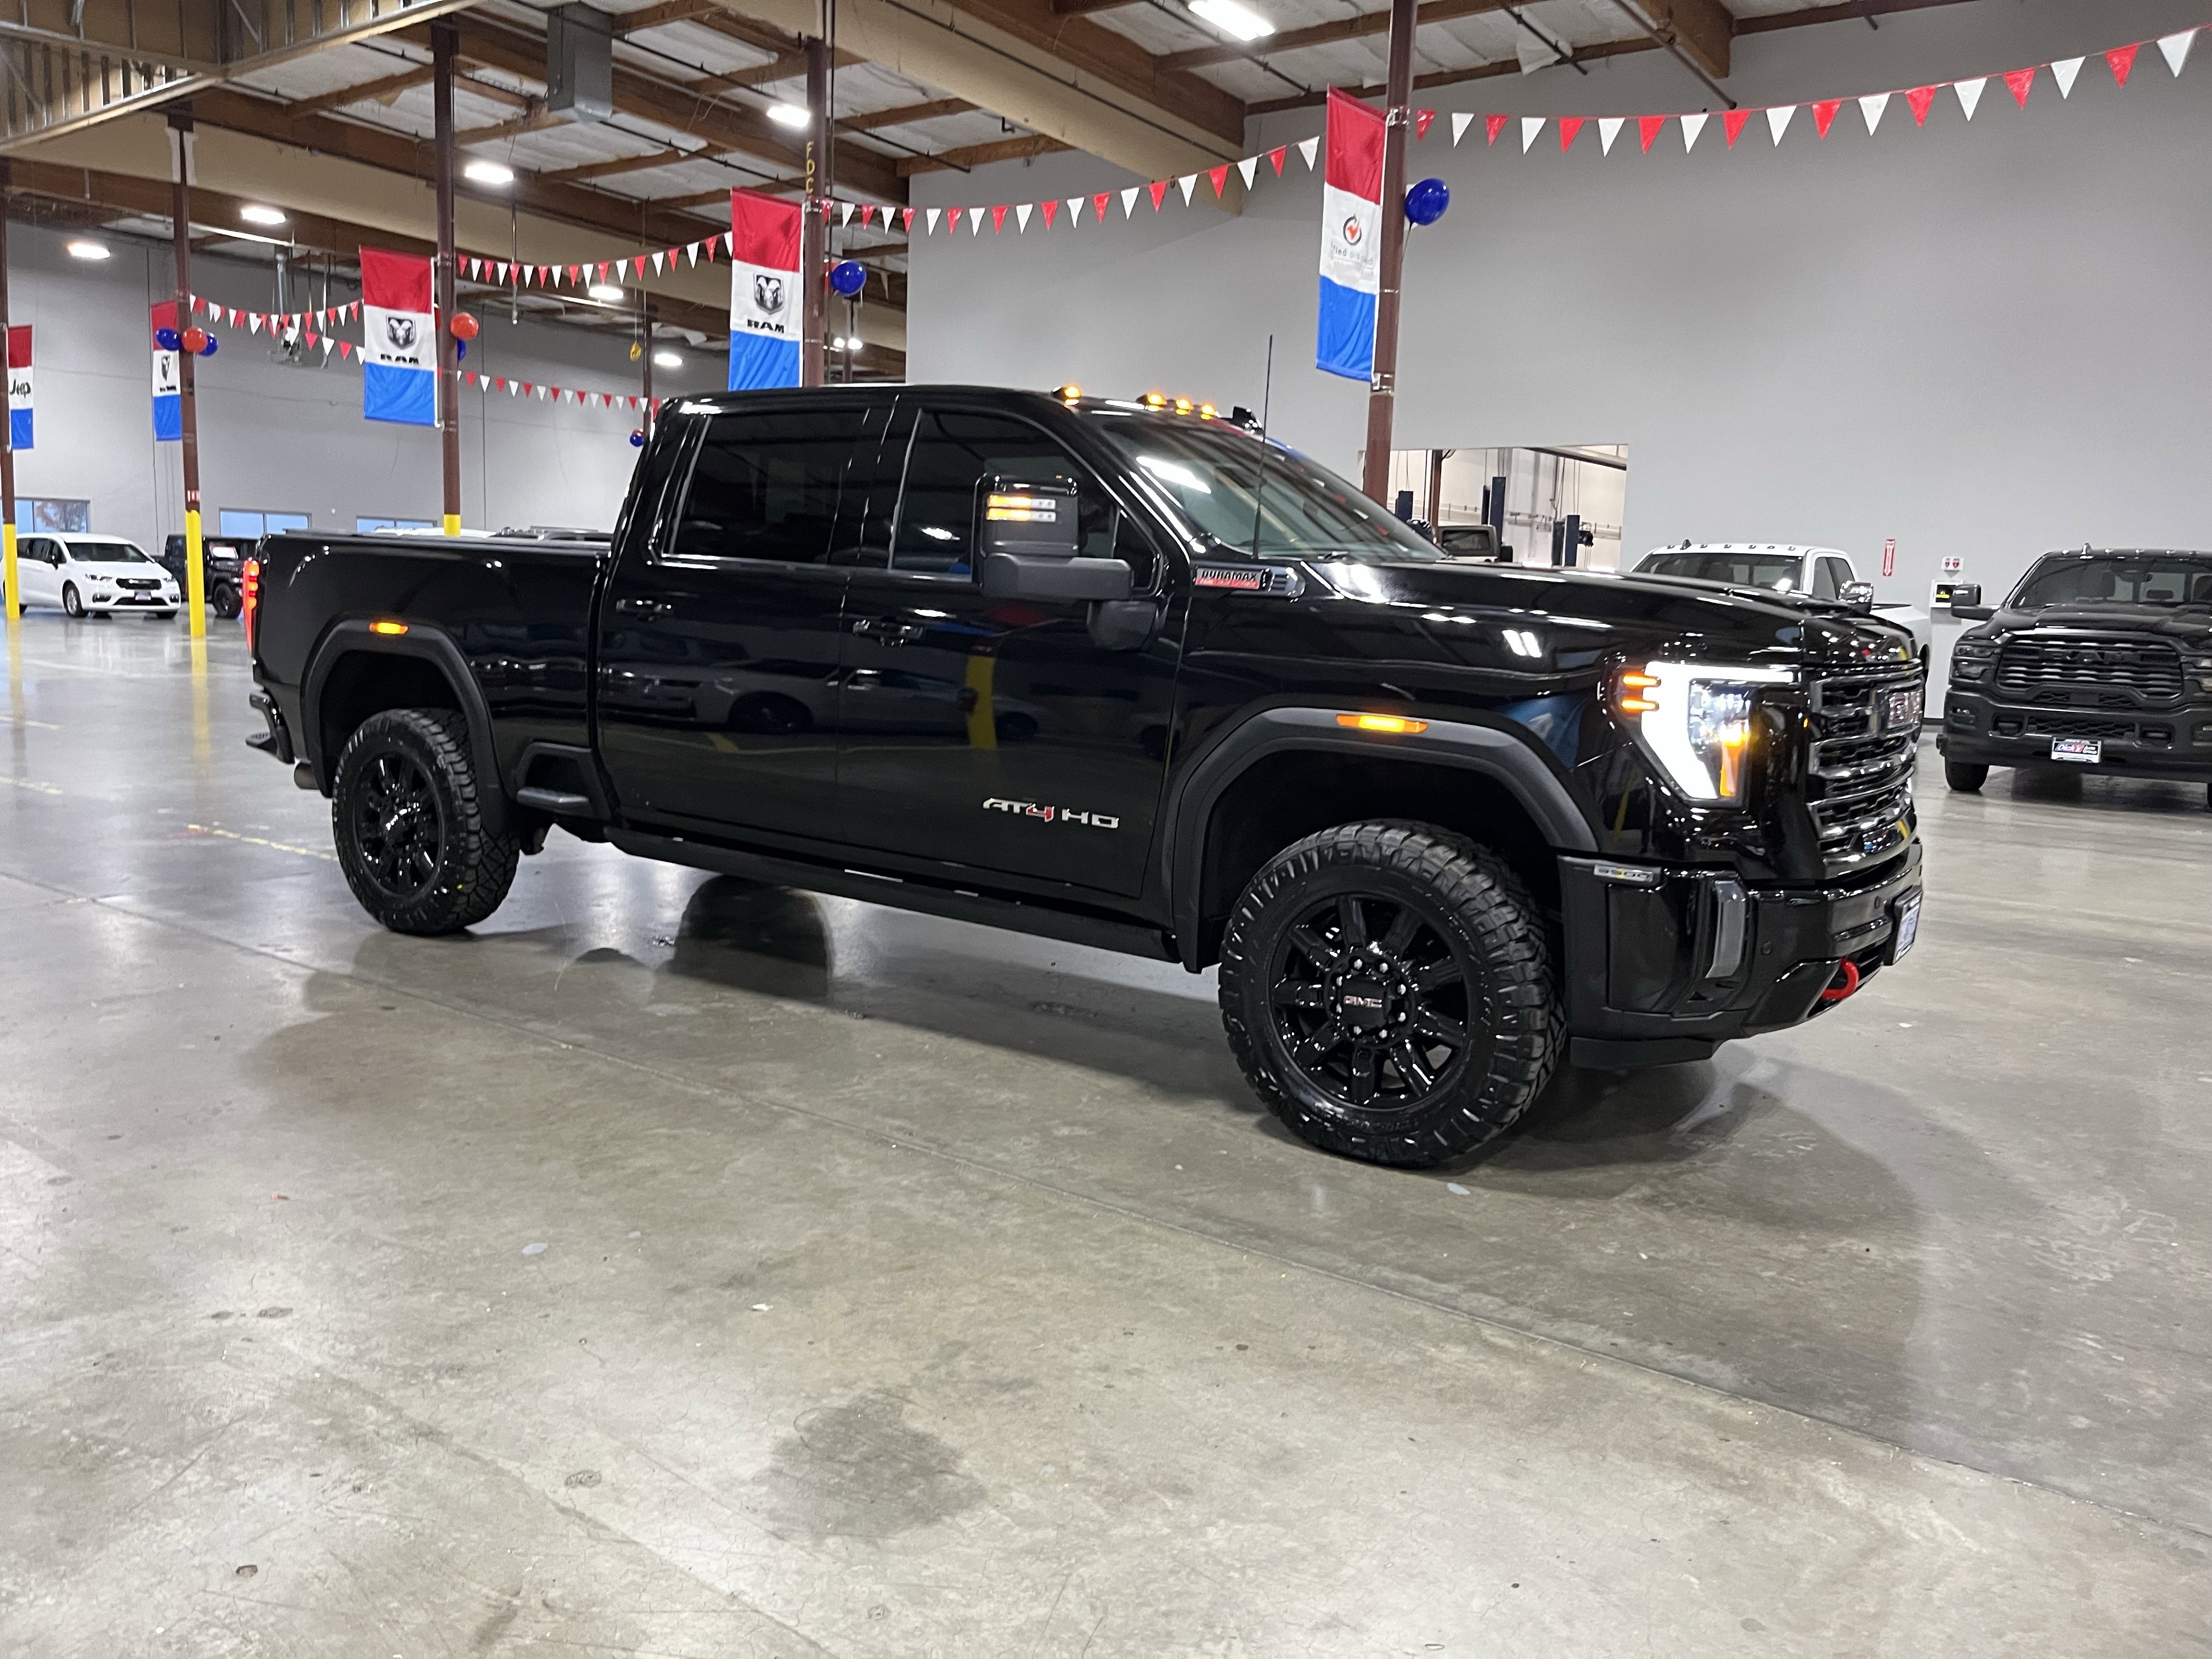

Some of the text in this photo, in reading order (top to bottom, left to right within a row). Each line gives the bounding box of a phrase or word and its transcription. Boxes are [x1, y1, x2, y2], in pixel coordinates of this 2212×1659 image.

[806, 140, 815, 194] FDC
[747, 318, 785, 334] RAM
[1201, 570, 1257, 581] DURAMAX
[1343, 995, 1382, 1008] GMC
